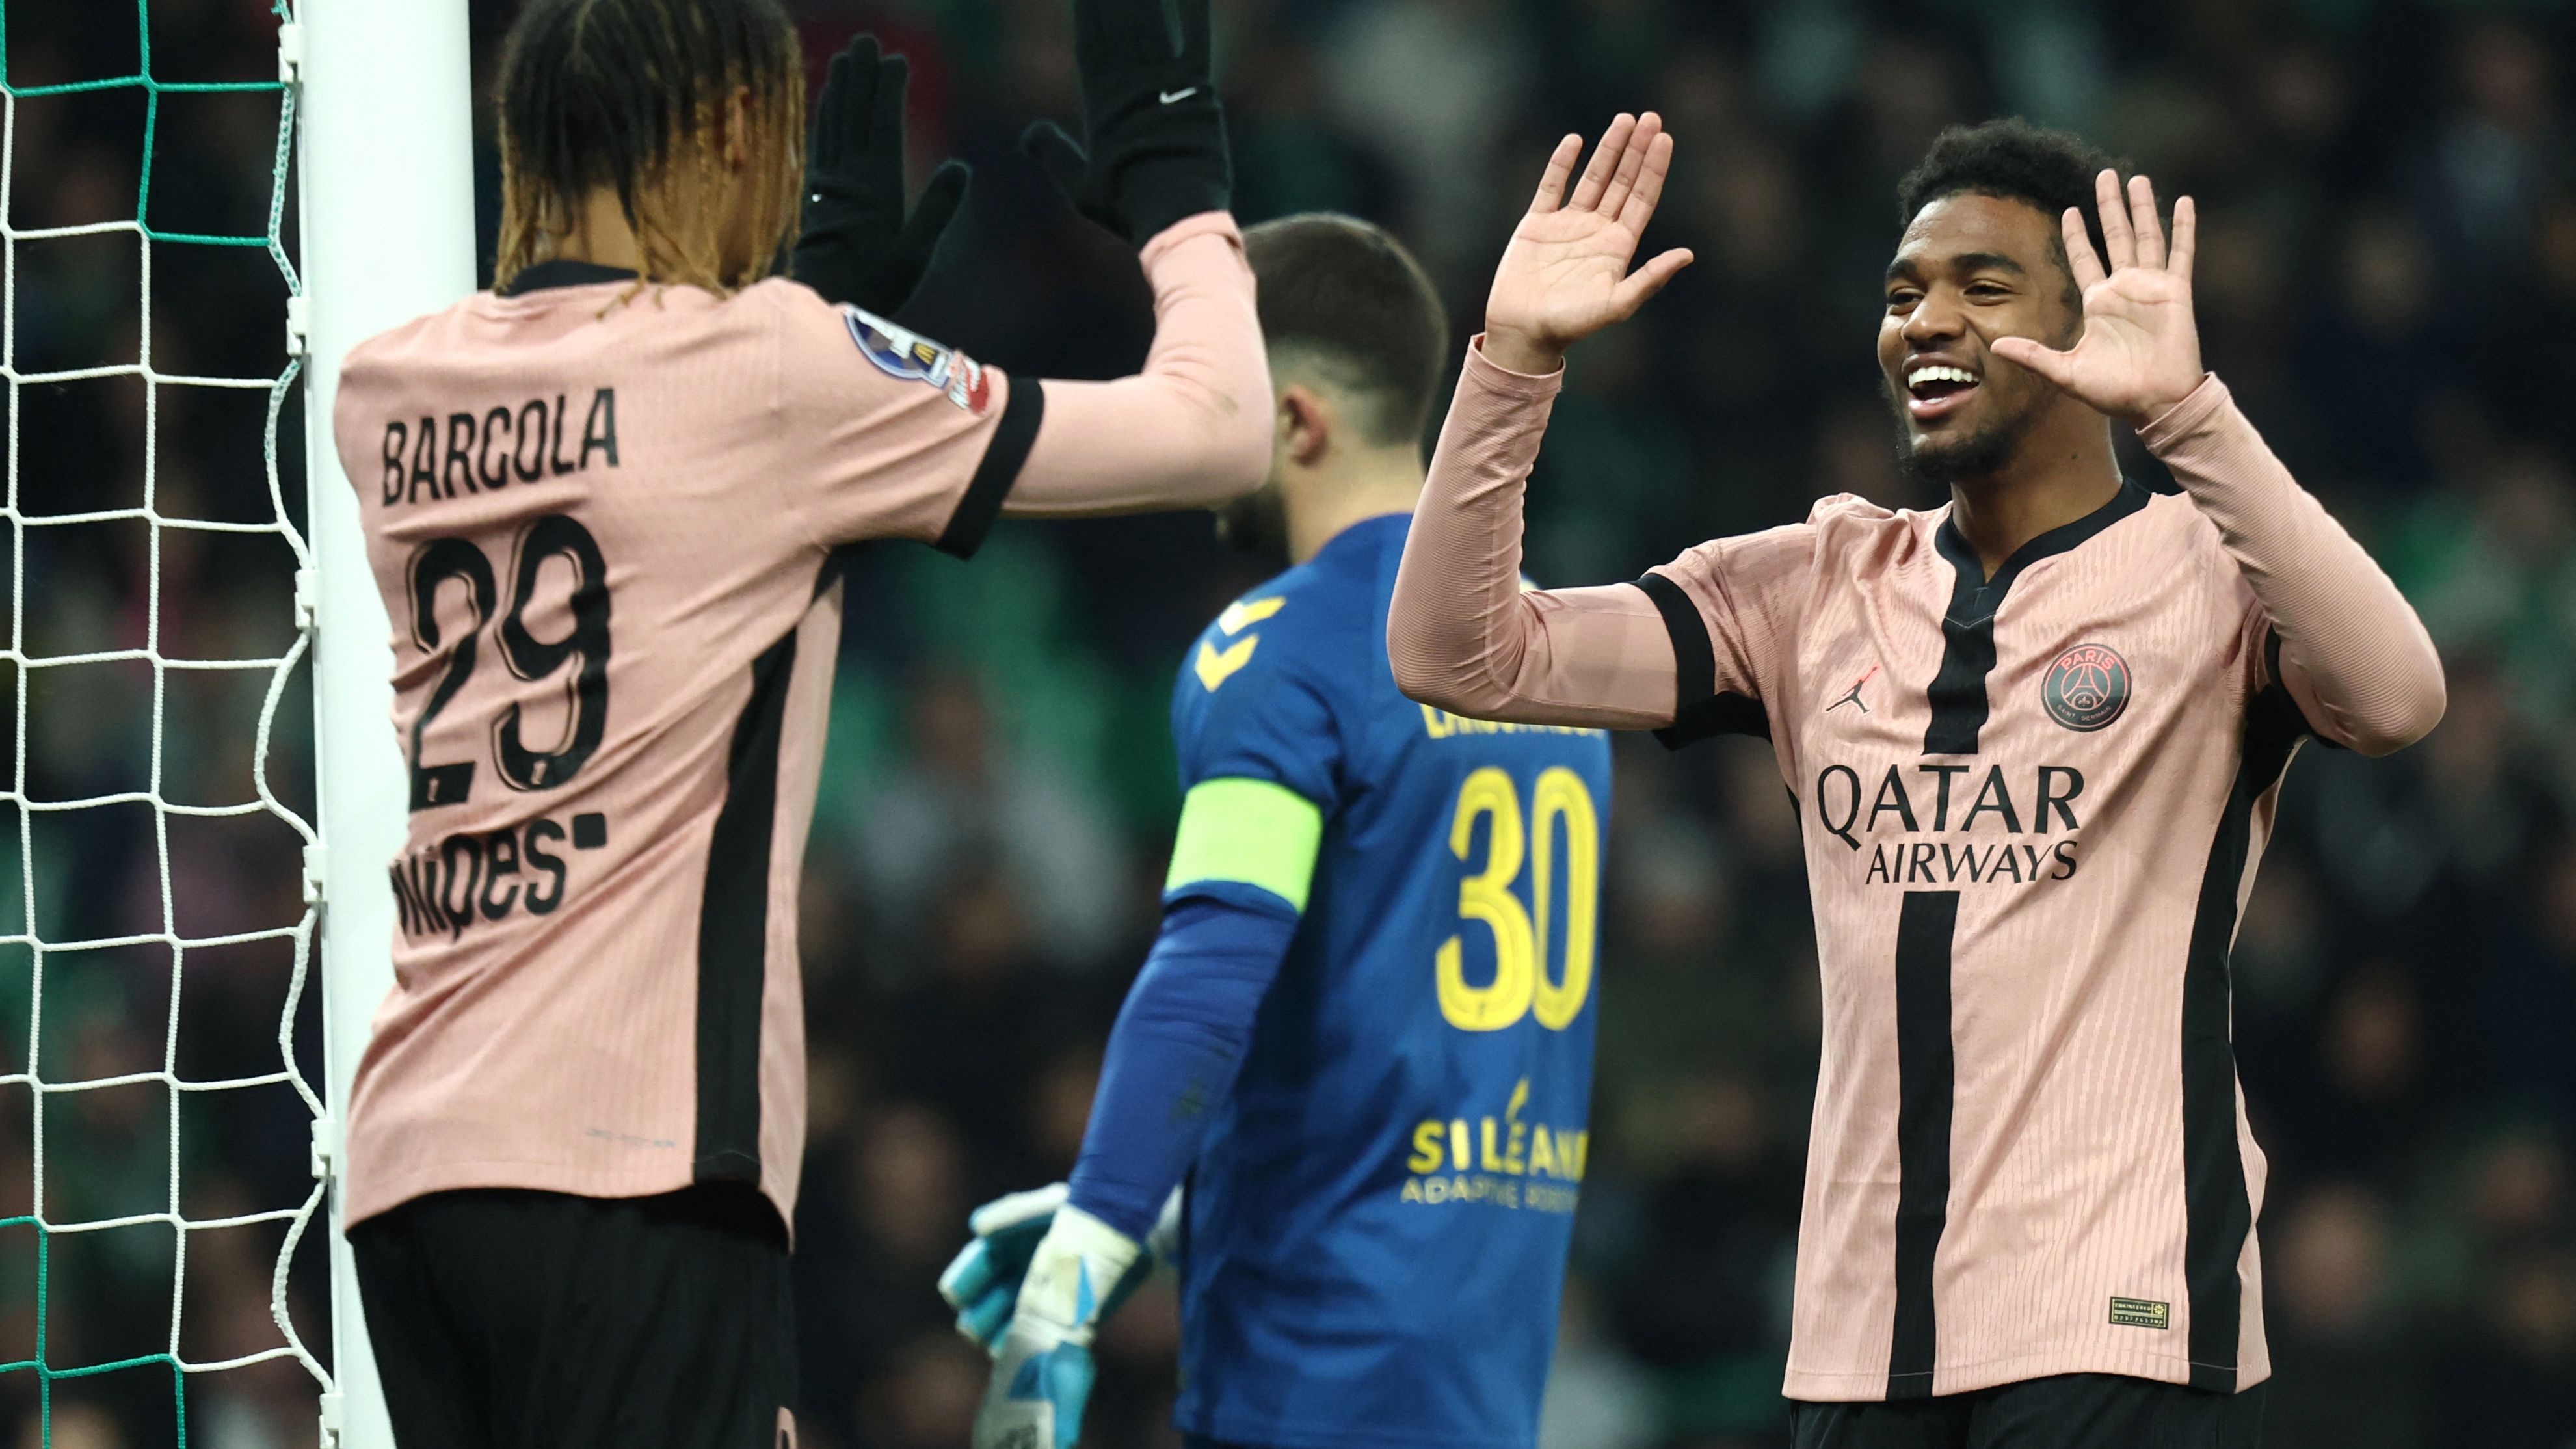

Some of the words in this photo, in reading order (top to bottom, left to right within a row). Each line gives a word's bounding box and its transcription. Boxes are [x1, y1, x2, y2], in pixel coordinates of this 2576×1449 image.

[382, 387, 620, 507] BARCOLA
[405, 514, 611, 813] 29
[2060, 650, 2115, 671] PARIS
[1817, 764, 2085, 852] QATAR
[1435, 765, 1600, 1032] 30
[1865, 840, 2078, 885] AIRWAYS
